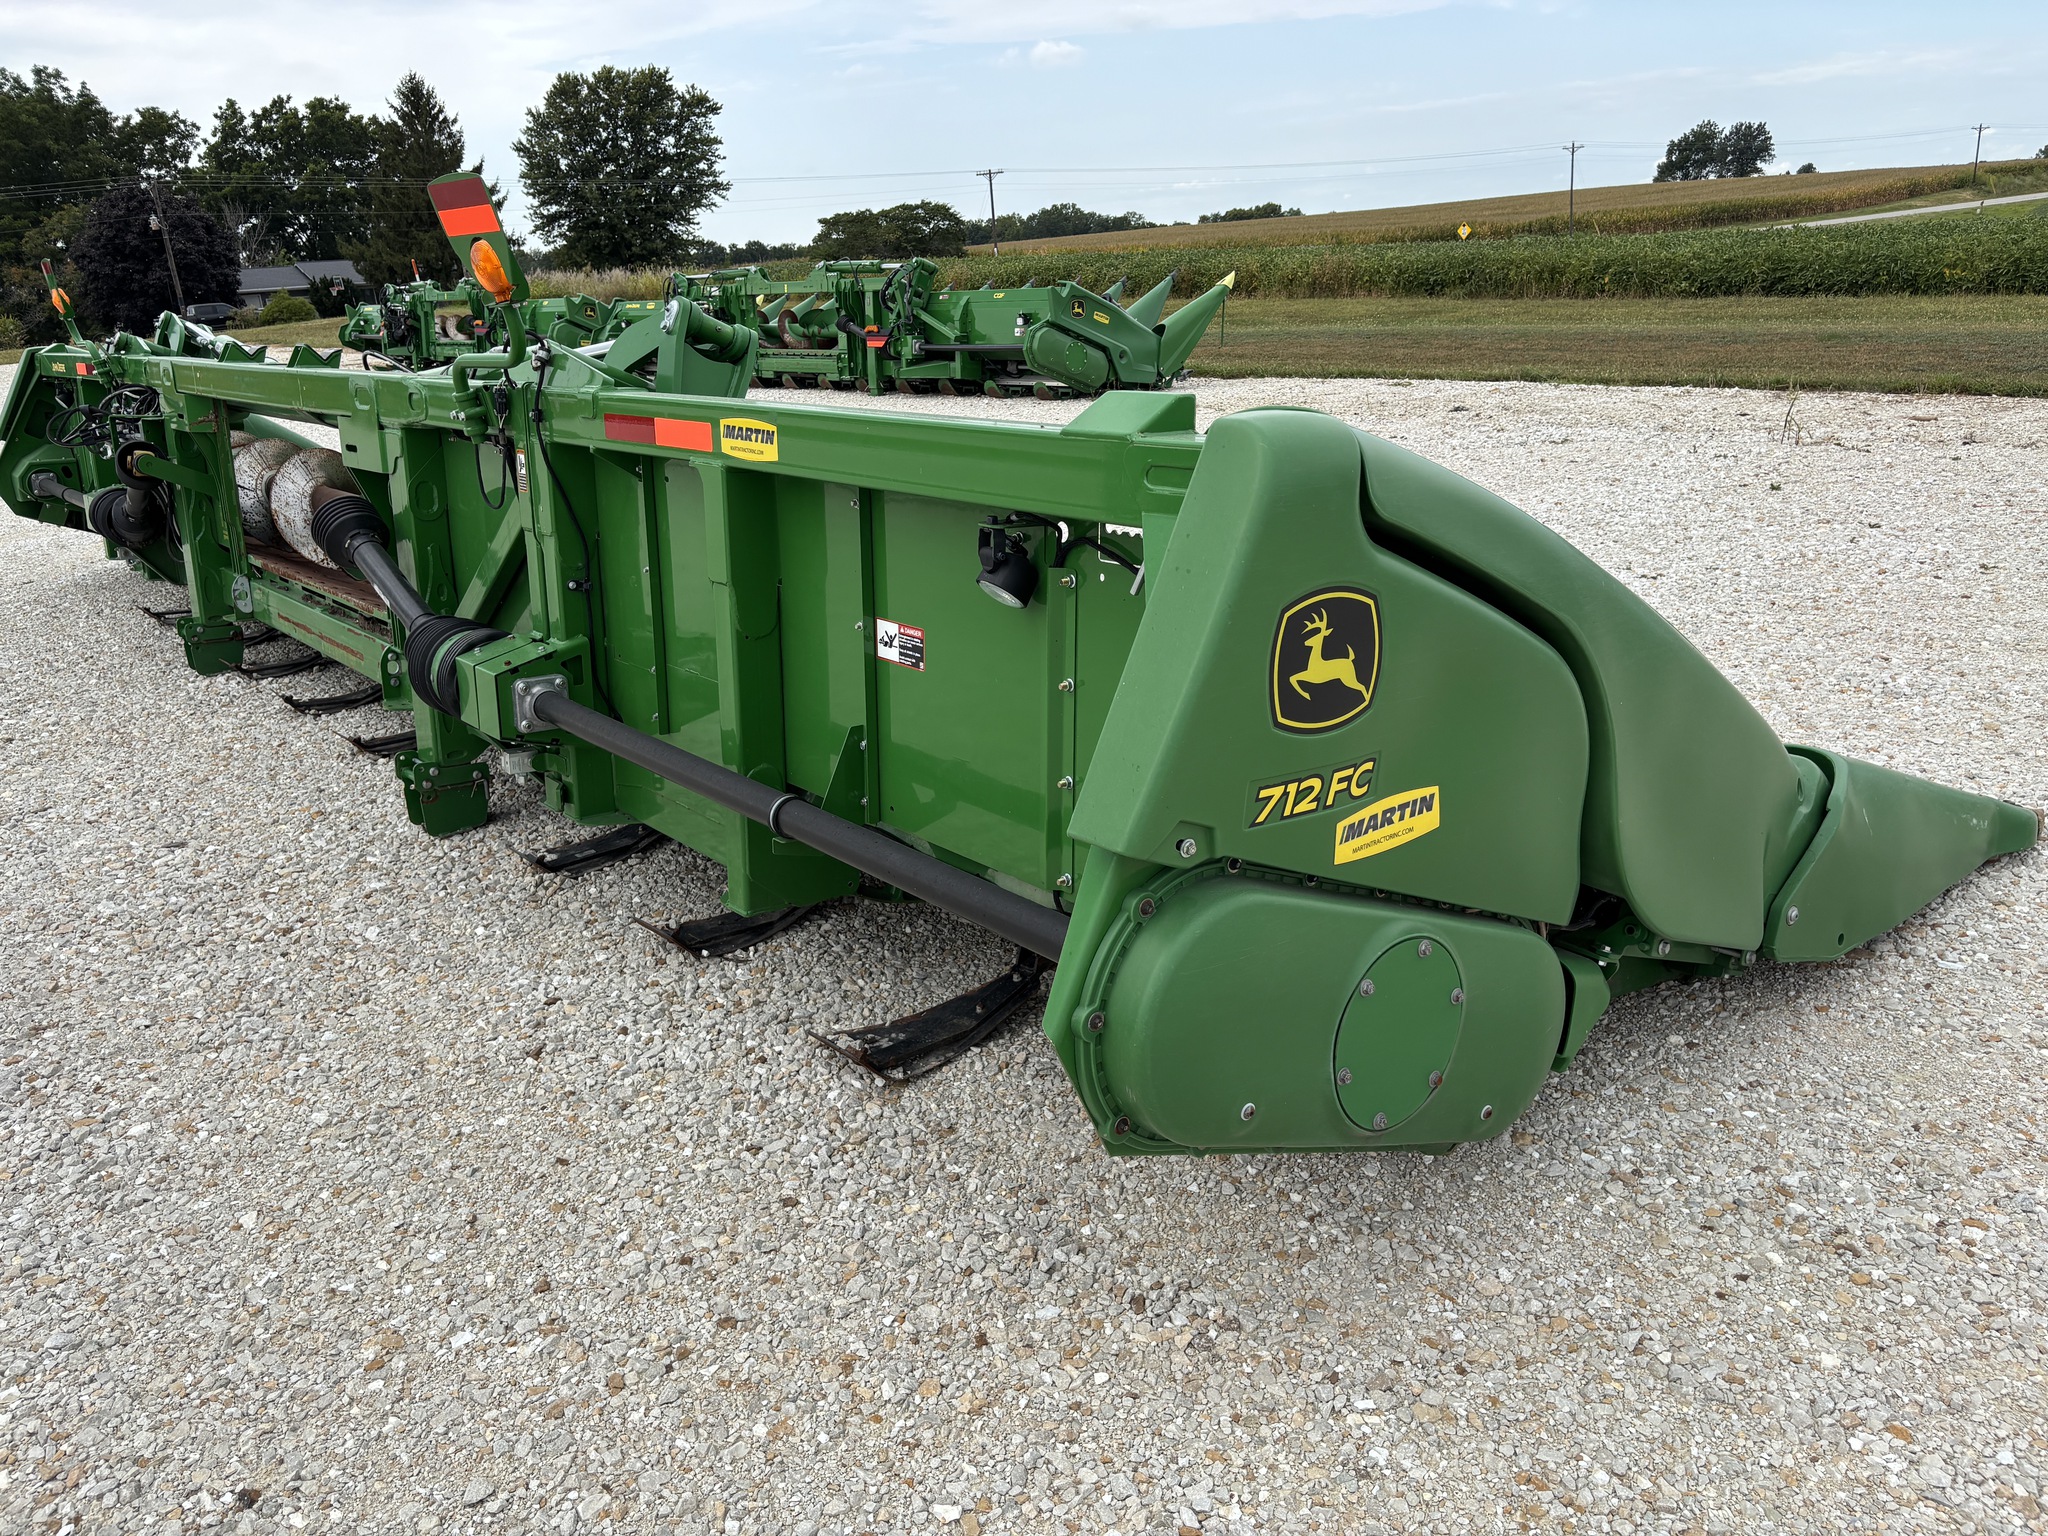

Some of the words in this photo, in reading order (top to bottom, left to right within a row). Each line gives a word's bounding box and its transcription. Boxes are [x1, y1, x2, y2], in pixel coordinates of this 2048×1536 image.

[723, 424, 775, 445] MARTIN
[1250, 774, 1325, 828] 712
[1323, 758, 1376, 809] FC
[1339, 793, 1435, 845] MARTIN
[1352, 826, 1415, 854] MARTINTRACTORINC.COM
